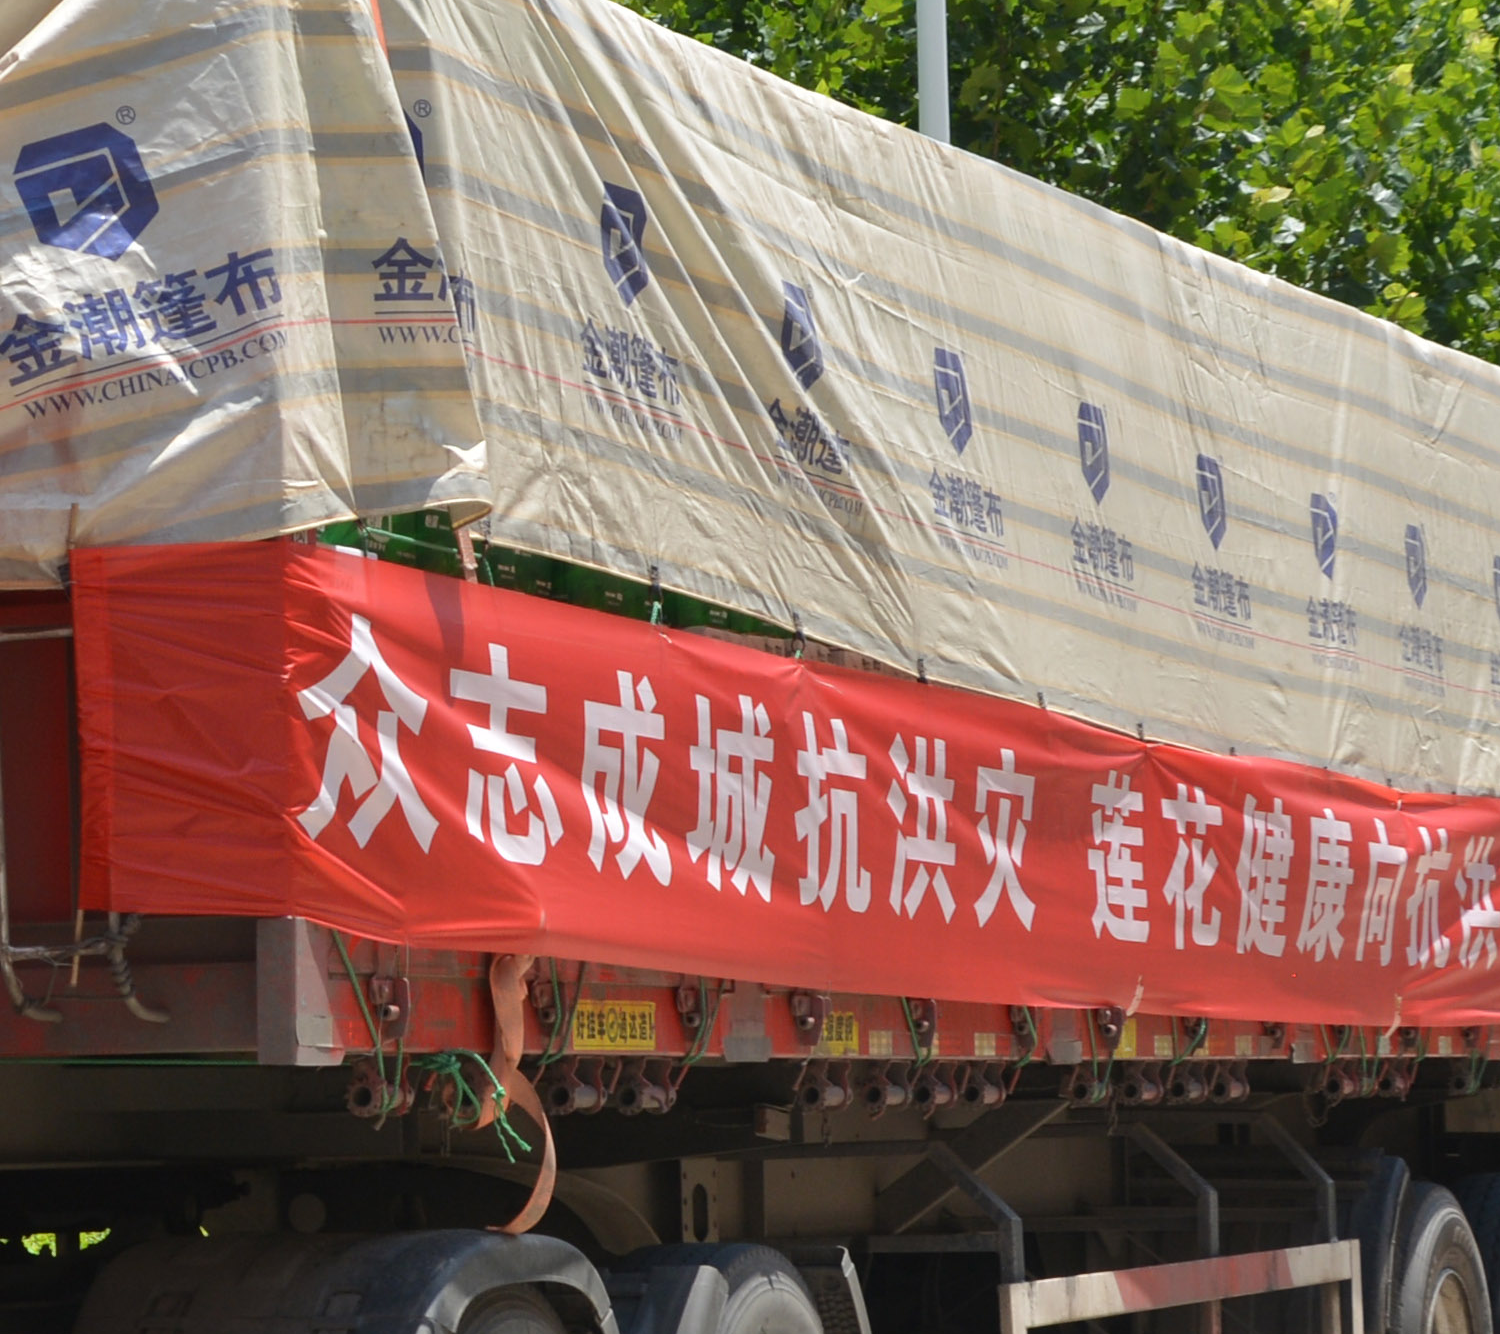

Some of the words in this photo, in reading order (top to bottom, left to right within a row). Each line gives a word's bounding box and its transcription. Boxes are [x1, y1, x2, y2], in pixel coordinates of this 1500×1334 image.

[296, 612, 1036, 931] 众志成城抗洪灾
